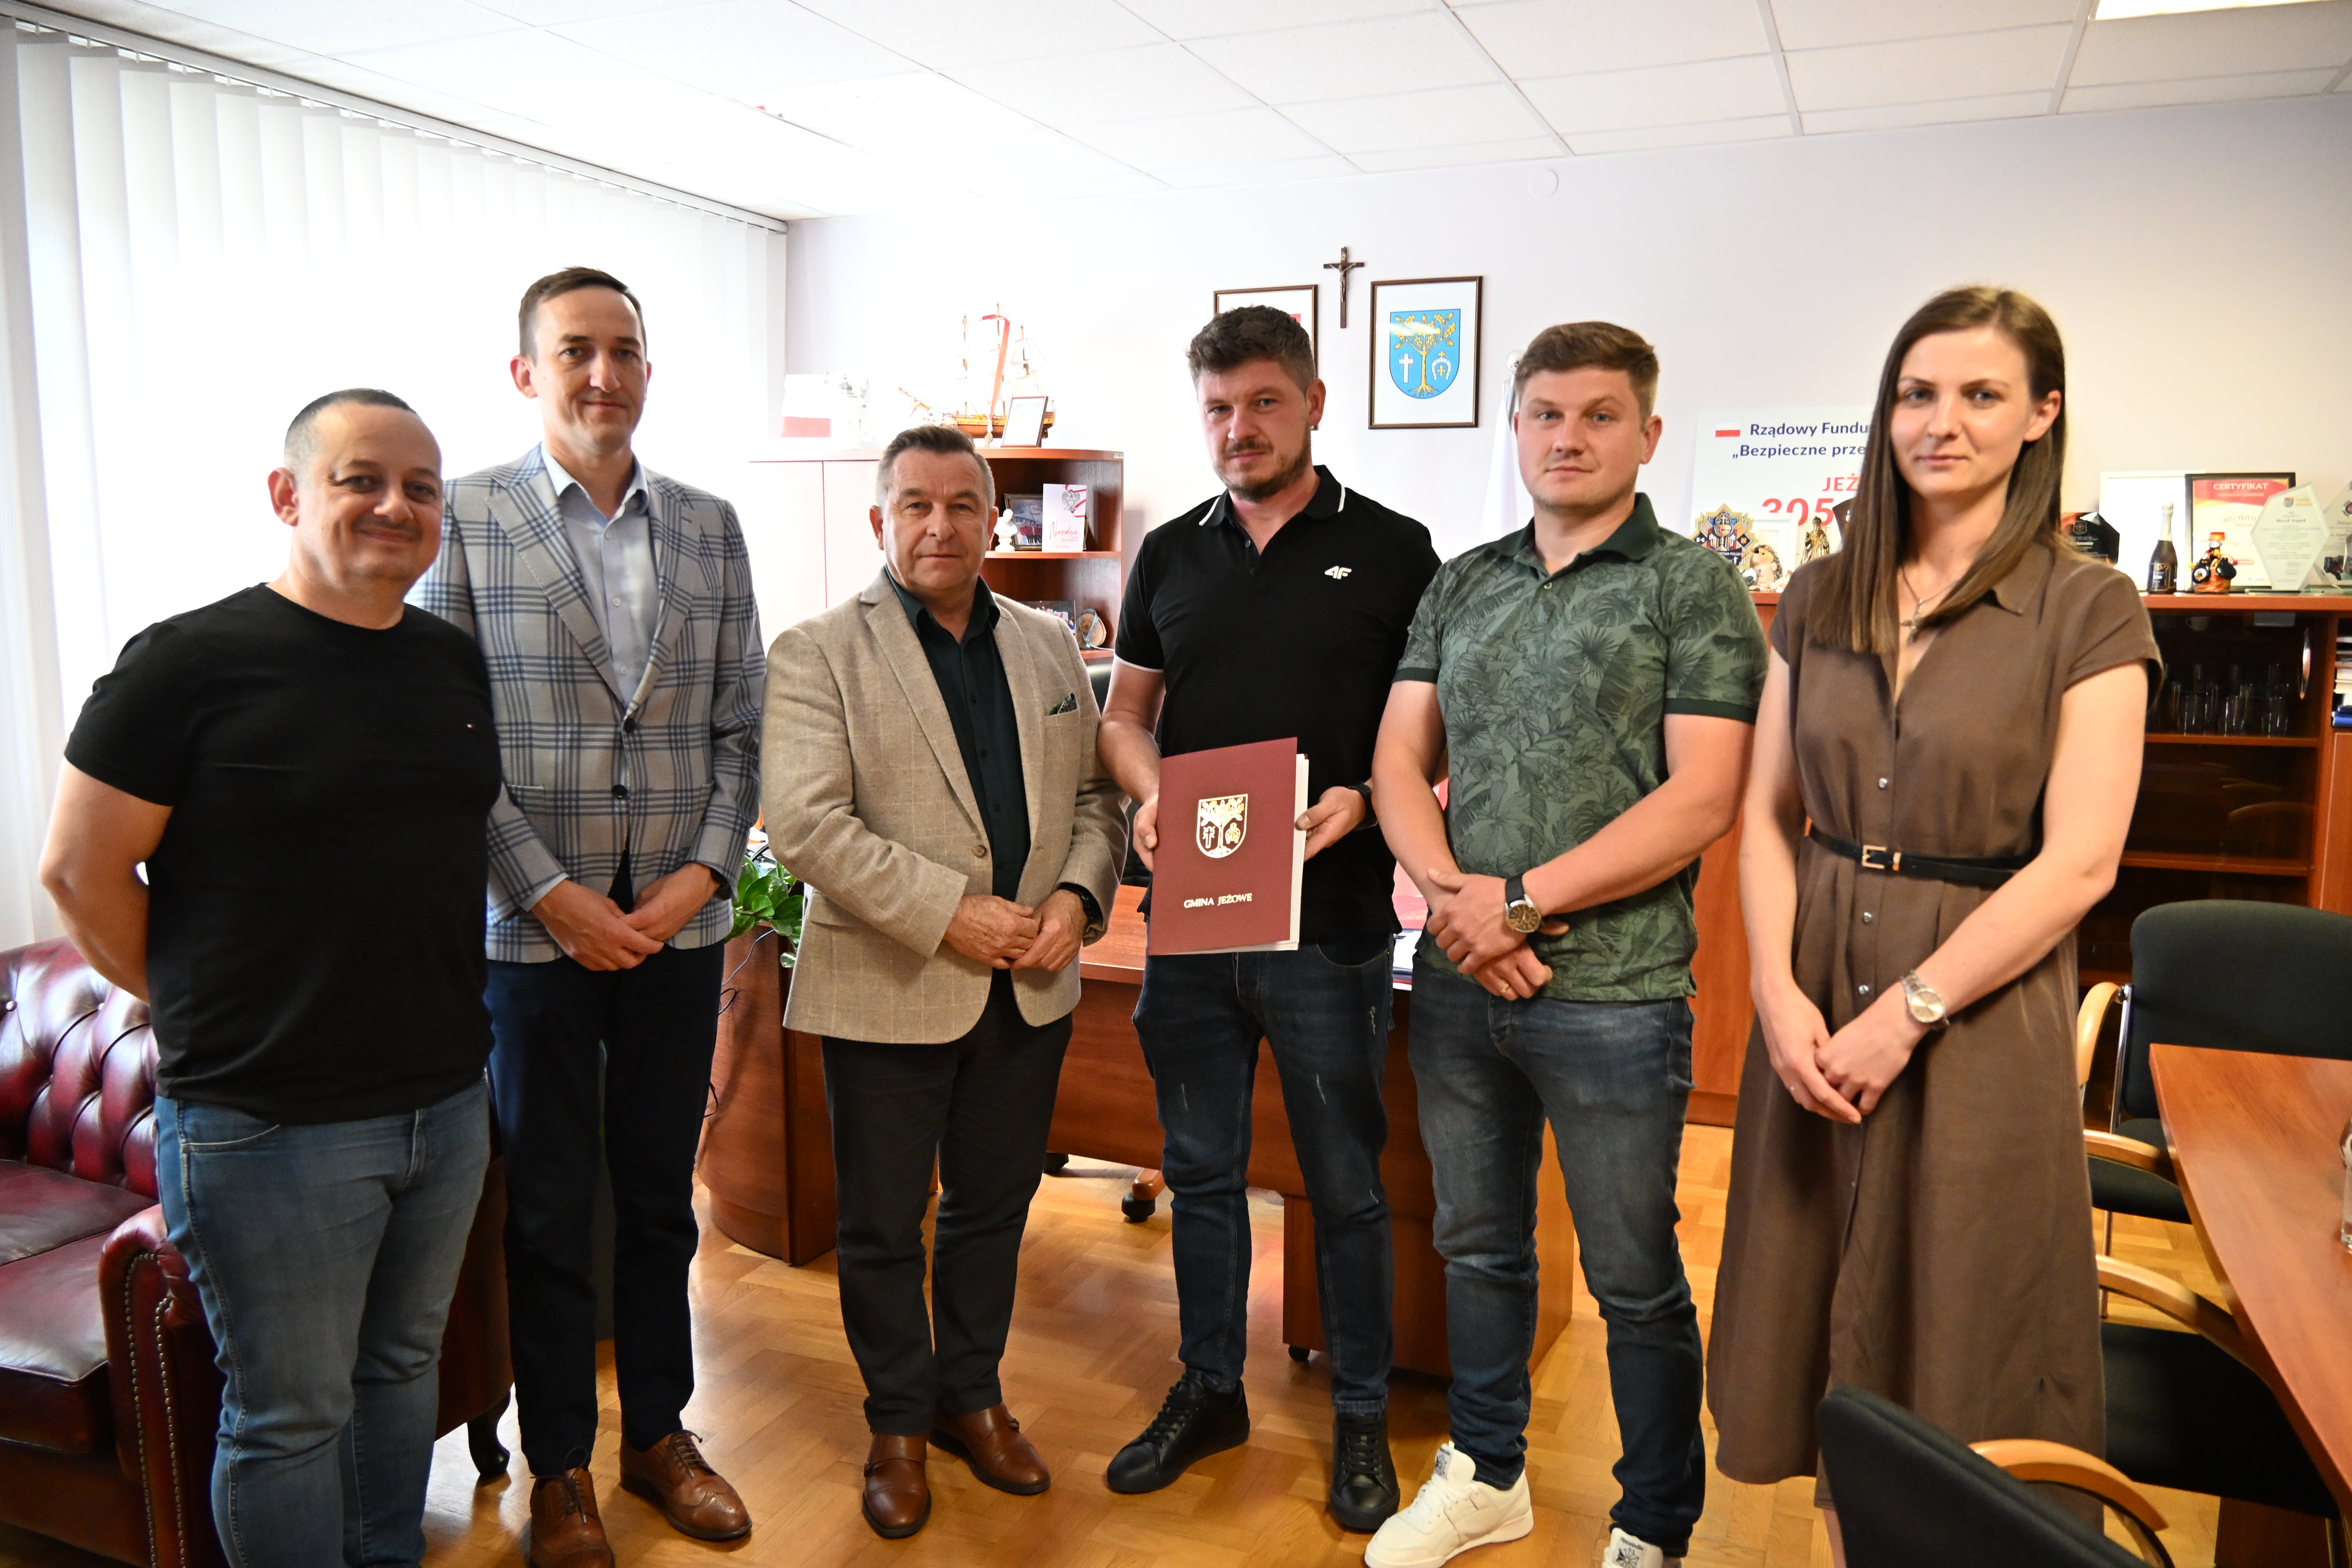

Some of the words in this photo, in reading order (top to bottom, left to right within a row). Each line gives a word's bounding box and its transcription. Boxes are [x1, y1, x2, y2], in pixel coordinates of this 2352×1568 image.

[1750, 423, 1818, 438] Rządowy
[1821, 422, 1868, 434] Fundu
[1832, 446, 1866, 457] prze
[1822, 473, 1860, 492] JEŻ
[1324, 565, 1352, 580] 4F
[1183, 897, 1214, 908] GMINA
[1217, 893, 1252, 906] JEŻOWE
